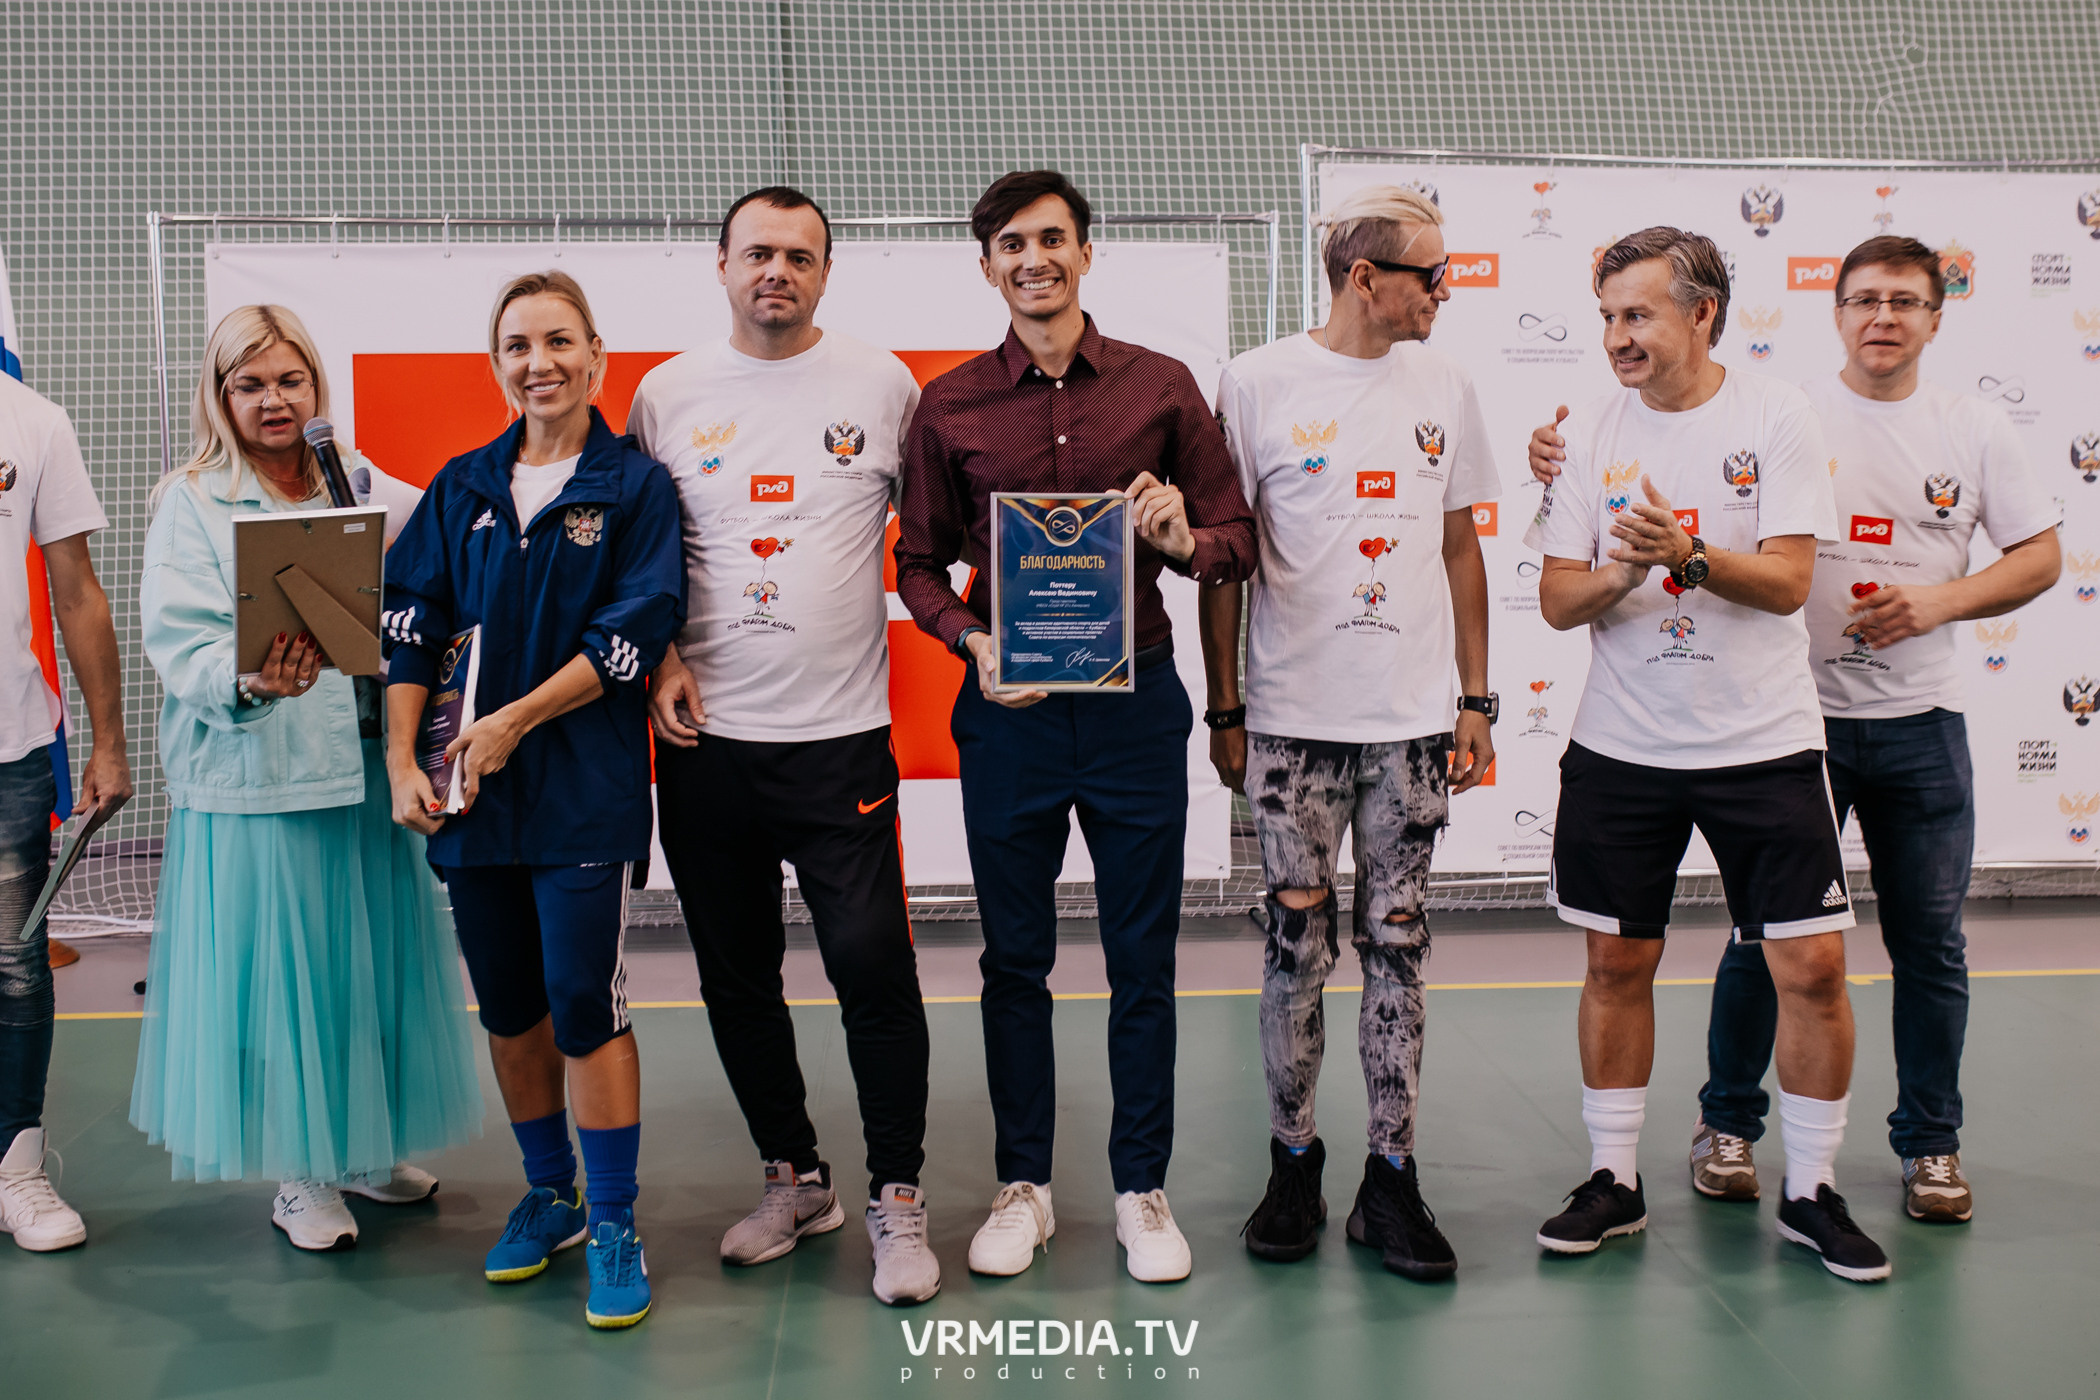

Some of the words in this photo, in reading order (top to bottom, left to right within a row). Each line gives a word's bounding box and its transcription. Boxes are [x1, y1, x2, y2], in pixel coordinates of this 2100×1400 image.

[1020, 555, 1105, 571] БЛАГОДАРНОСТЬ
[2019, 740, 2050, 750] СПОРТ
[2018, 751, 2056, 760] НОРМА
[2018, 762, 2056, 771] ЖИЗНИ
